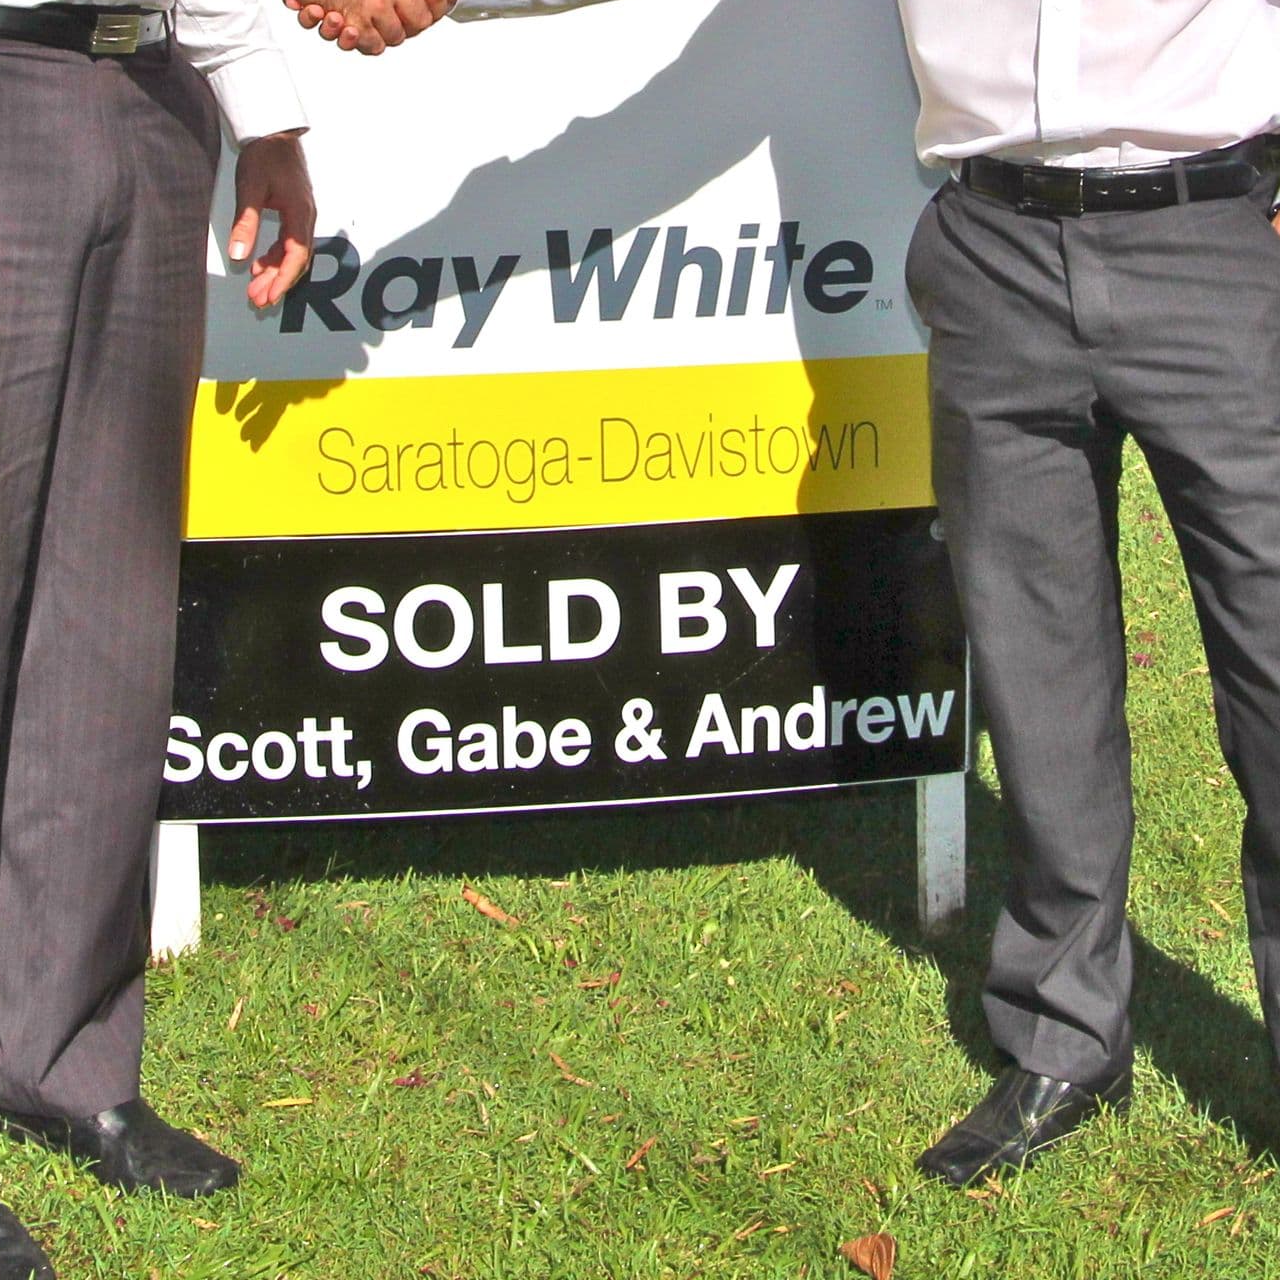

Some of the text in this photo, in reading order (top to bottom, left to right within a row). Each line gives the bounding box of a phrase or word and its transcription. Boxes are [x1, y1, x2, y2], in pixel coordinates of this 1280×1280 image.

[280, 236, 521, 349] Ray
[546, 220, 874, 324] White
[318, 413, 880, 505] Saratoga-Davistown
[319, 564, 801, 672] SOLD BY
[163, 686, 955, 790] Scott, Gabe & Andrew
